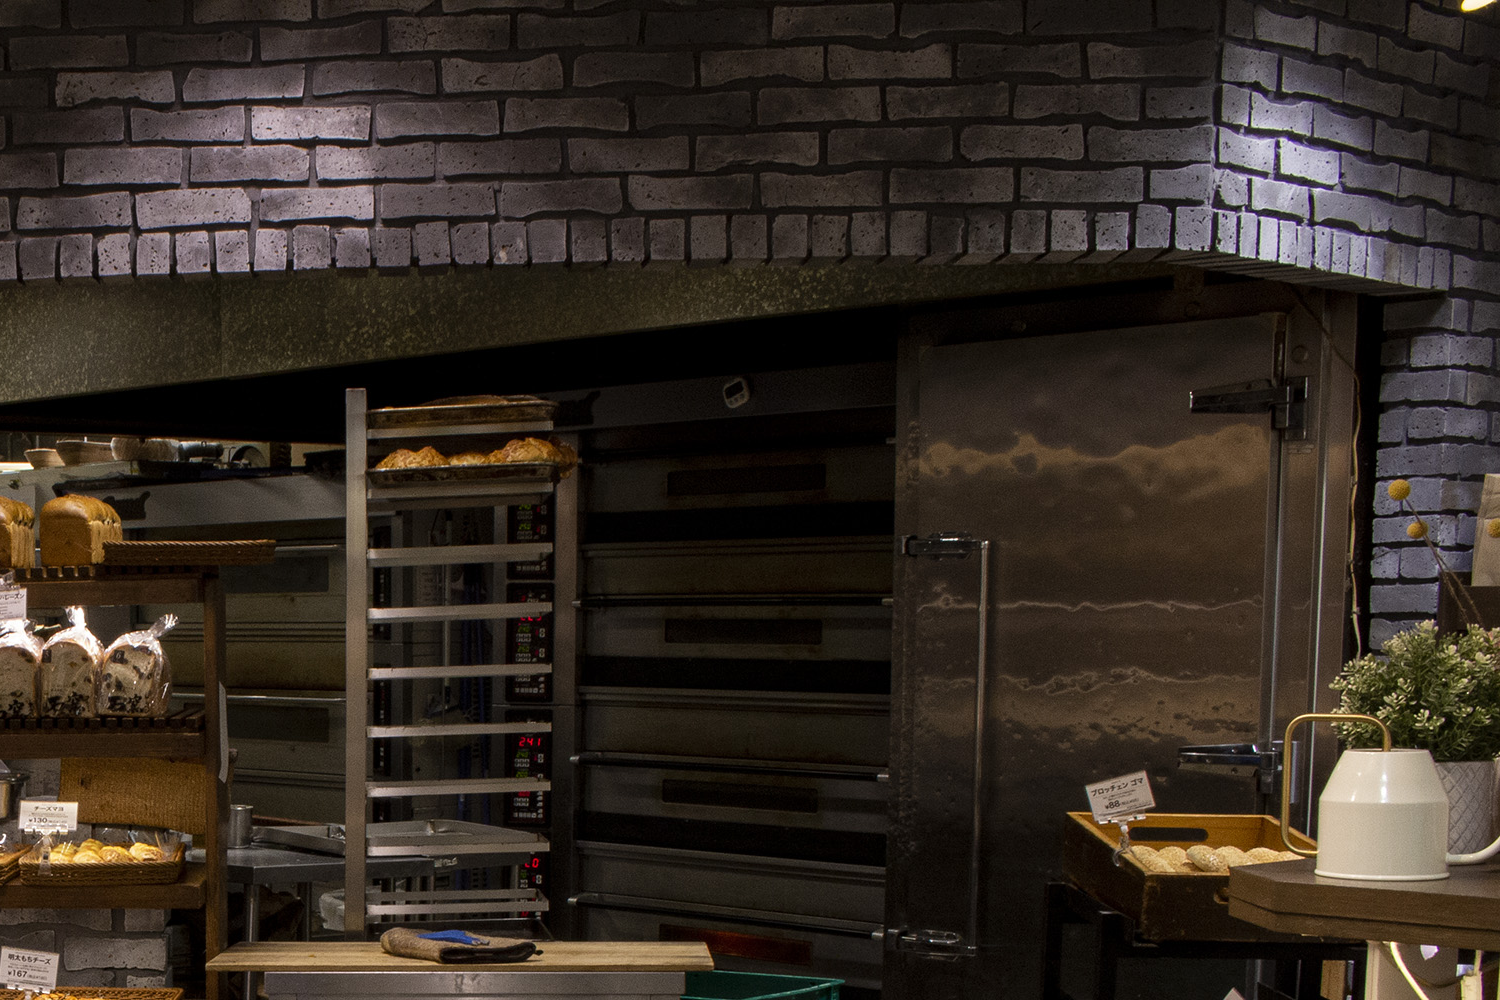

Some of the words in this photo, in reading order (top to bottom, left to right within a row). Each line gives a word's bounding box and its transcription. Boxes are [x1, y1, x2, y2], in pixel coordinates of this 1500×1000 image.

[1091, 782, 1128, 796] ブロッチェン
[1130, 777, 1144, 786] ゴマ
[1105, 800, 1120, 809] ¥88
[8, 953, 52, 965] 明太もちチーズ
[8, 970, 27, 978] ¥167
